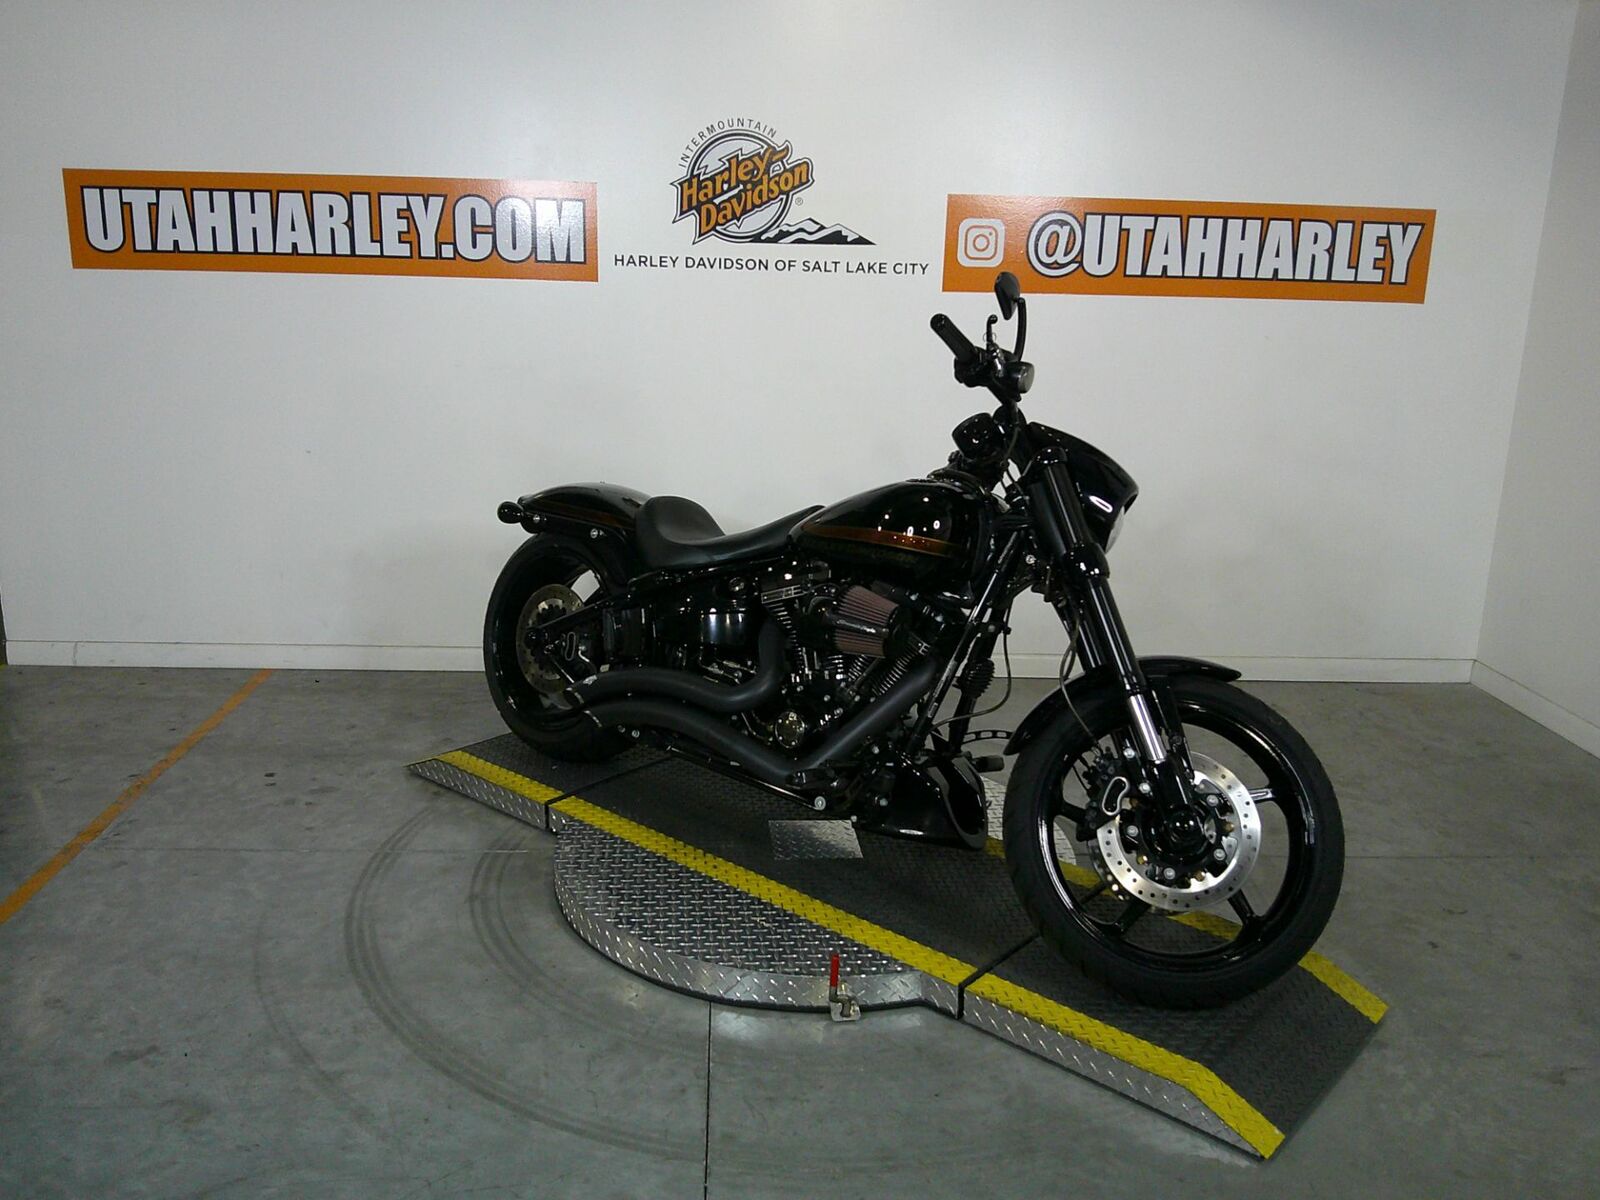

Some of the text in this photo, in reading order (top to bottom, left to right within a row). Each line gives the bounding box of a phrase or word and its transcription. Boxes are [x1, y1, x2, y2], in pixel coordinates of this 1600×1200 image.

[679, 117, 777, 168] INTERMOUNTAIN
[80, 185, 588, 265] UTAHHARLEY.COM
[700, 160, 809, 235] Davidson
[614, 254, 929, 276] HARLEY DAVIDSON OF SALT LAKE CITY
[1026, 210, 1426, 286] @UTAHHARLEY
